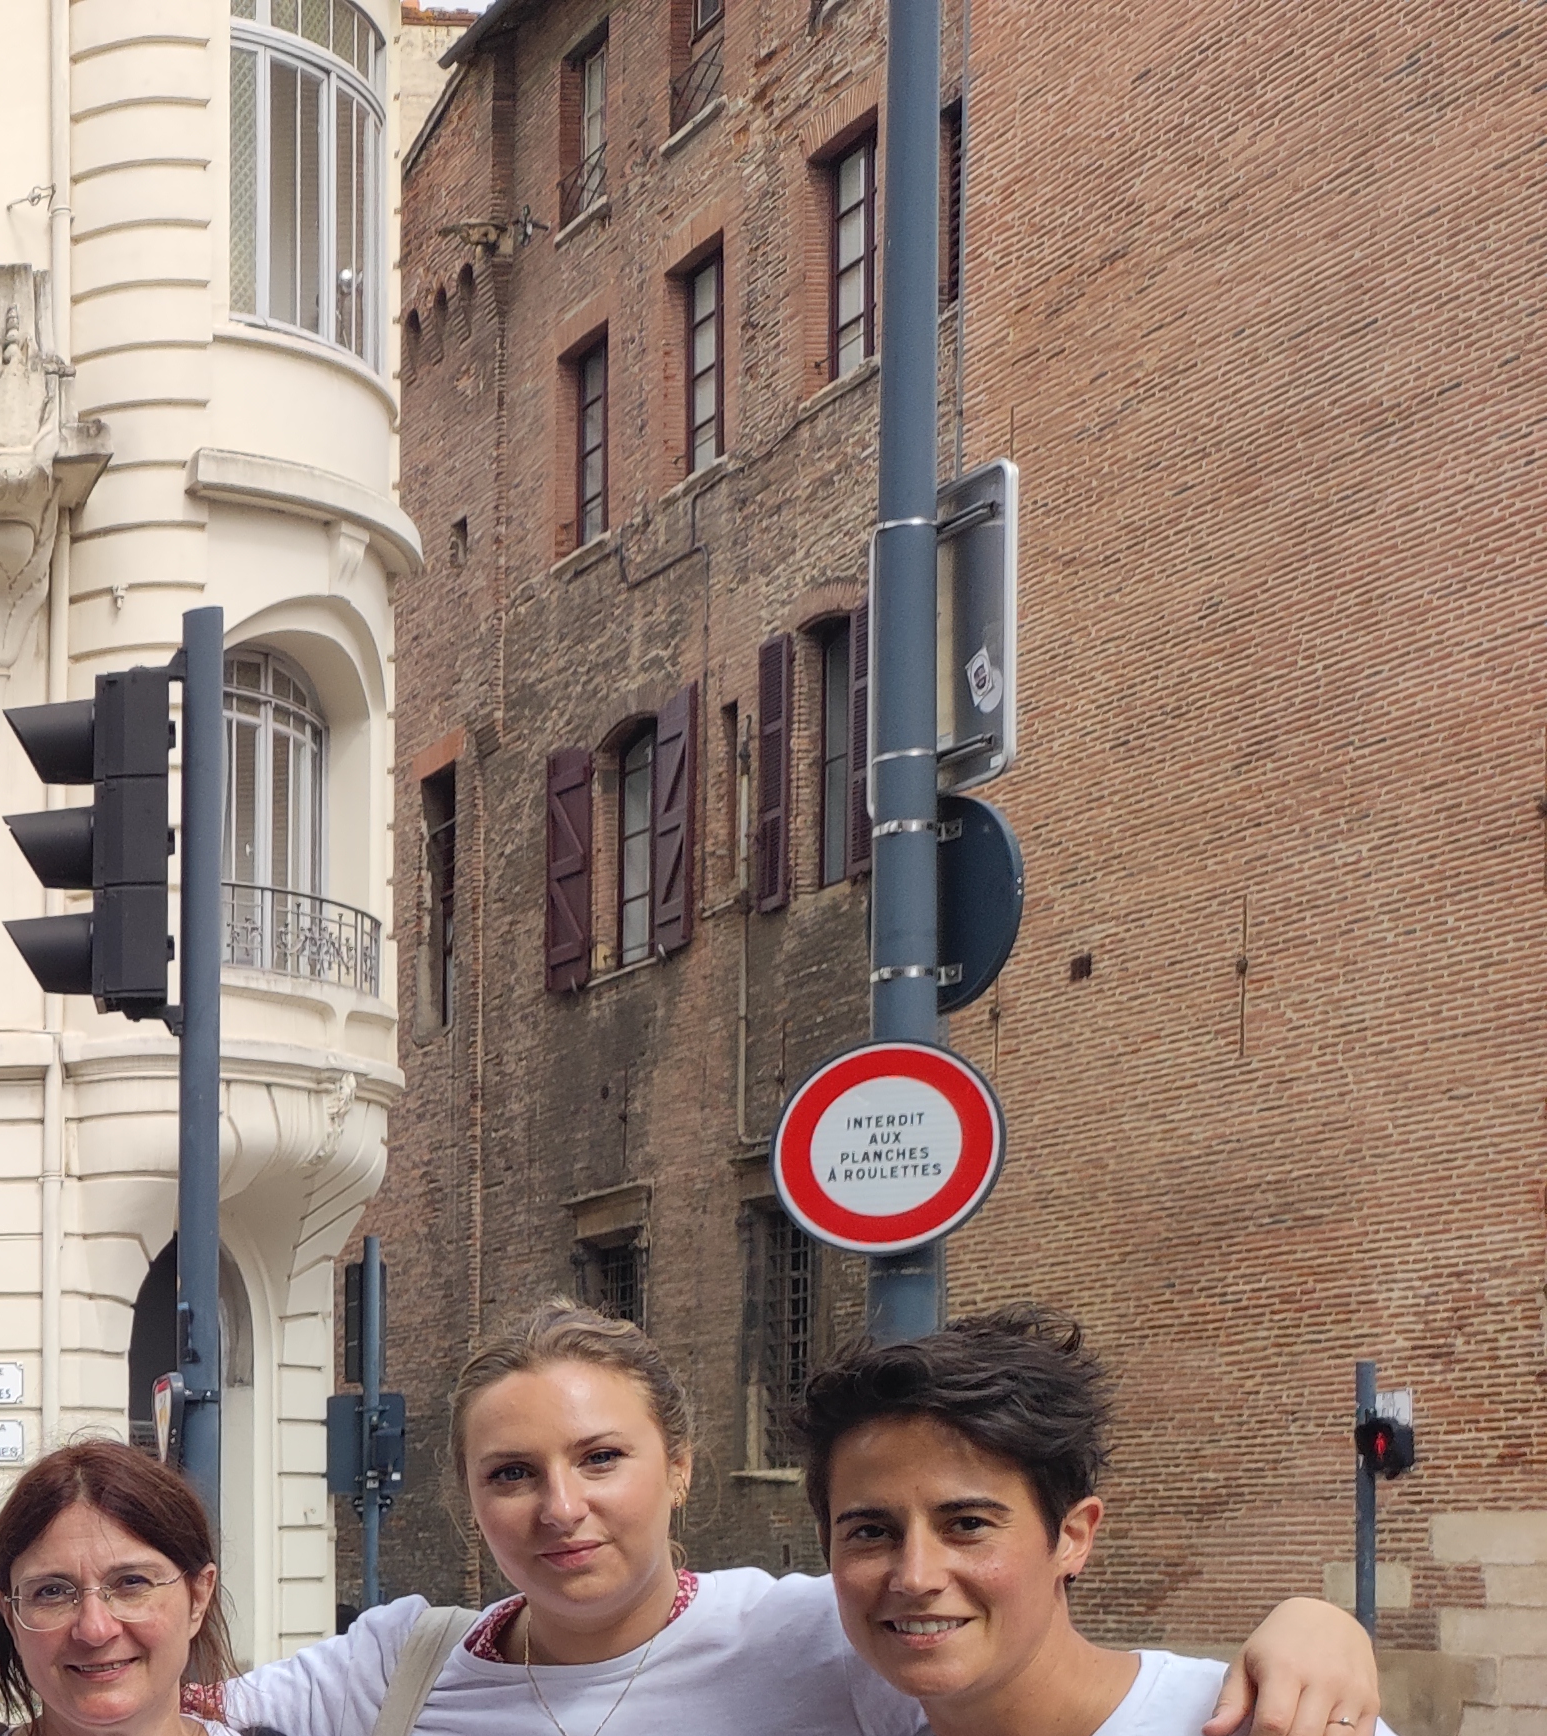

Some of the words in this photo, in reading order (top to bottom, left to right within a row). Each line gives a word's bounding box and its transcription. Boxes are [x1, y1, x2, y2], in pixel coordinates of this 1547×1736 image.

[847, 1112, 924, 1130] INTERDIT
[869, 1131, 902, 1145] AUX
[840, 1147, 929, 1164] PLANCHES
[844, 1163, 942, 1182] ROULETTES
